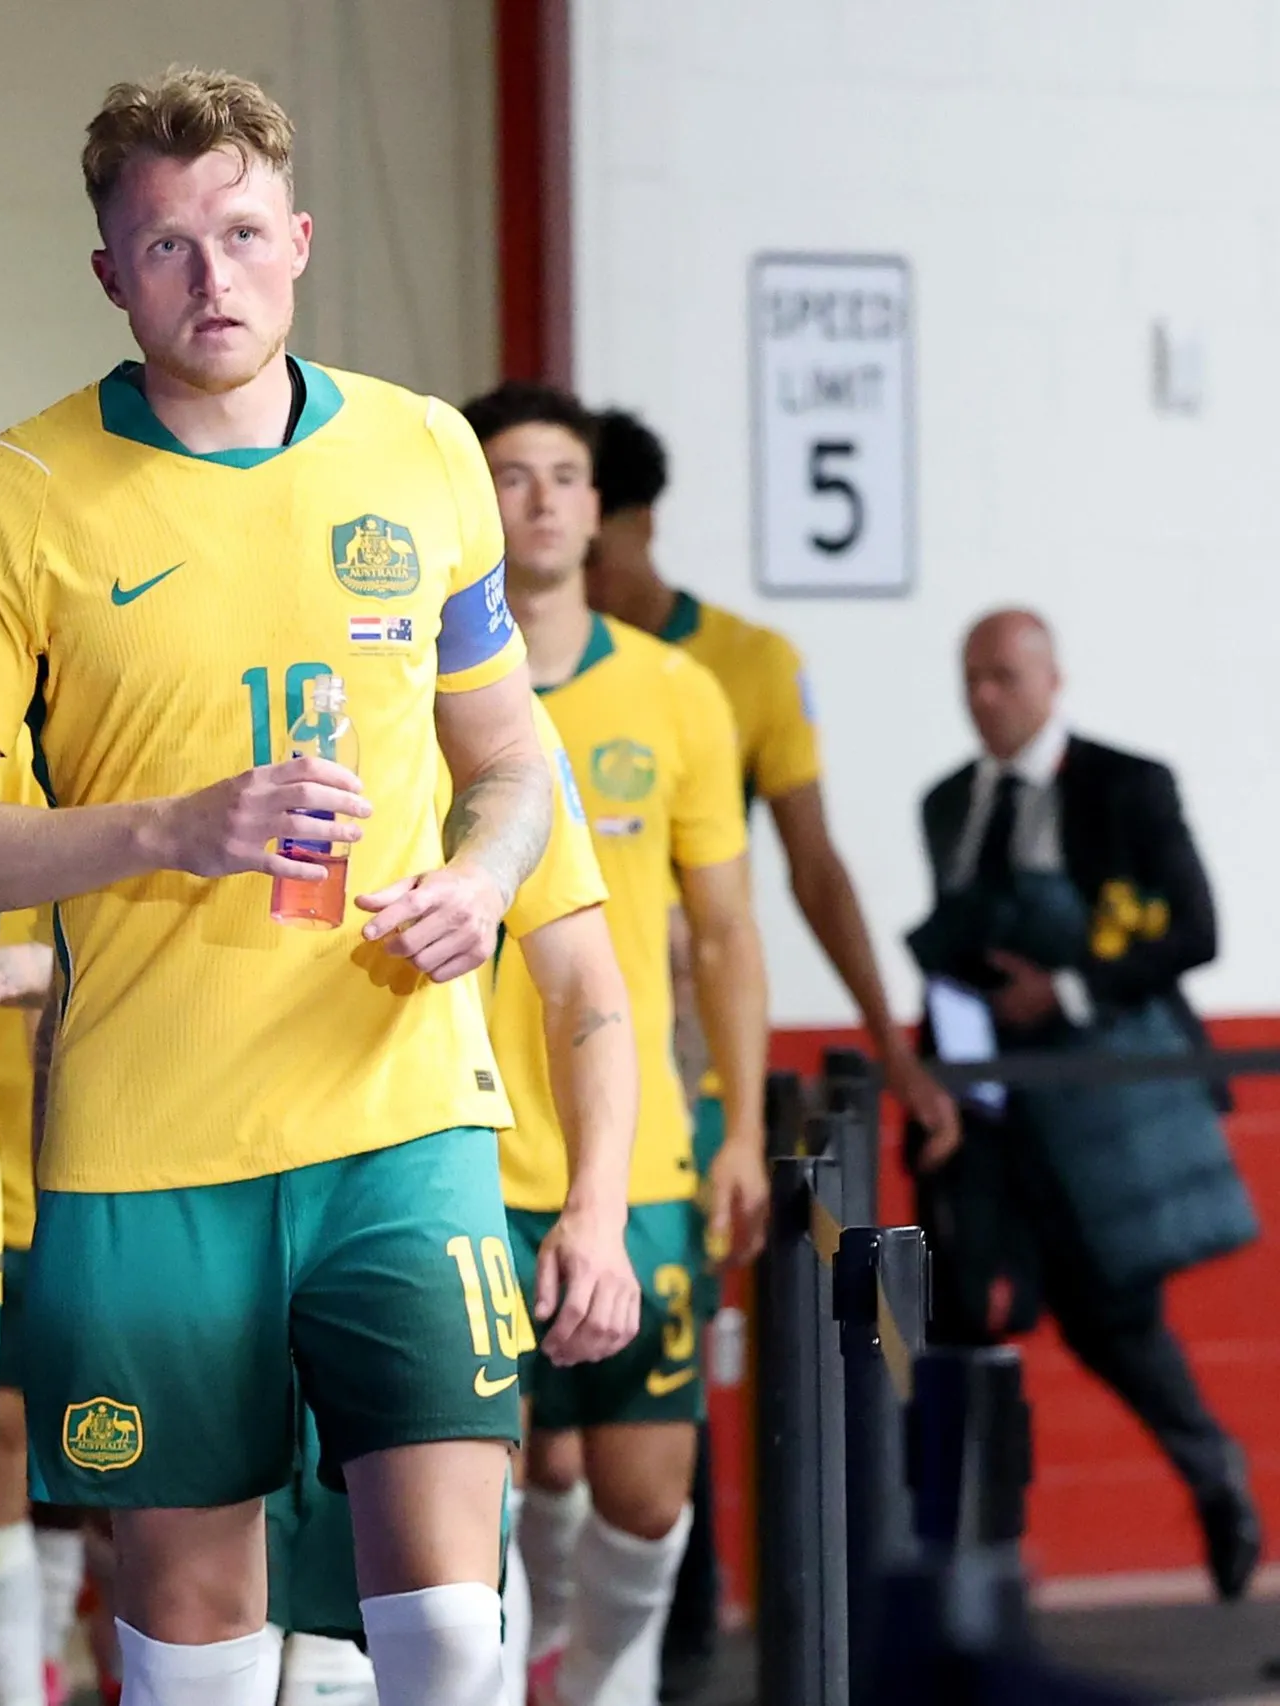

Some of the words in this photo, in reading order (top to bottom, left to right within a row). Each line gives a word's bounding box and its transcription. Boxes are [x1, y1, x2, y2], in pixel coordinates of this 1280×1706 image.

[762, 288, 907, 341] SPEED
[777, 364, 884, 413] LIMIT
[808, 439, 865, 556] 5
[349, 566, 409, 579] AUSTRALIA
[446, 1236, 537, 1360] 19
[654, 1263, 695, 1362] 3
